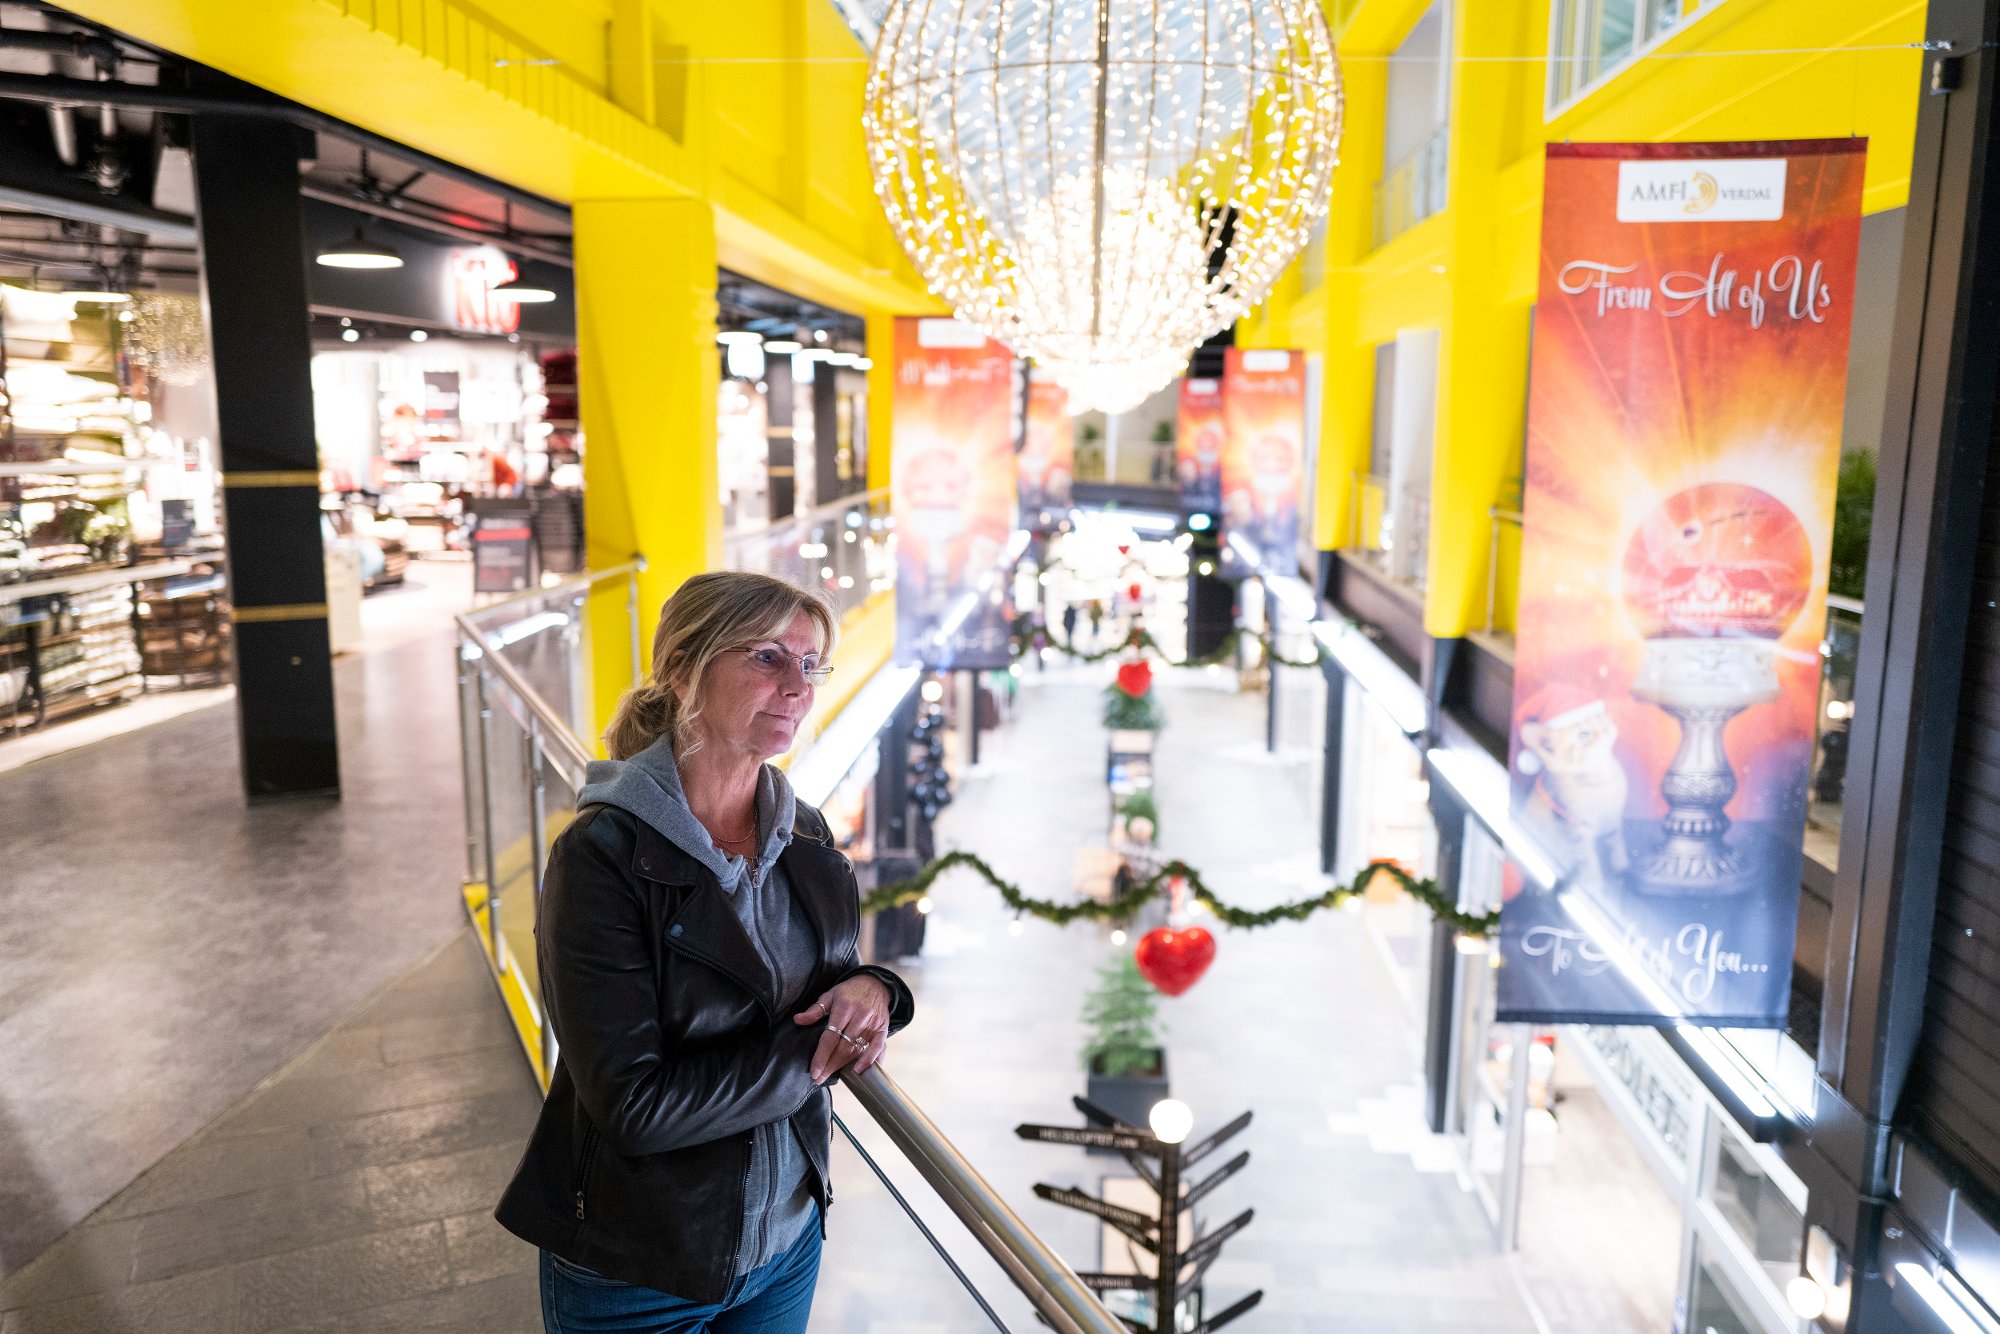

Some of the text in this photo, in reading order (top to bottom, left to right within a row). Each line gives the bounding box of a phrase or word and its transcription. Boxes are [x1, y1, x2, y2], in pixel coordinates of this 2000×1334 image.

[1631, 180, 1772, 202] AMFI VERDAL
[1558, 252, 1831, 329] From All of Us
[1521, 925, 1590, 975] To
